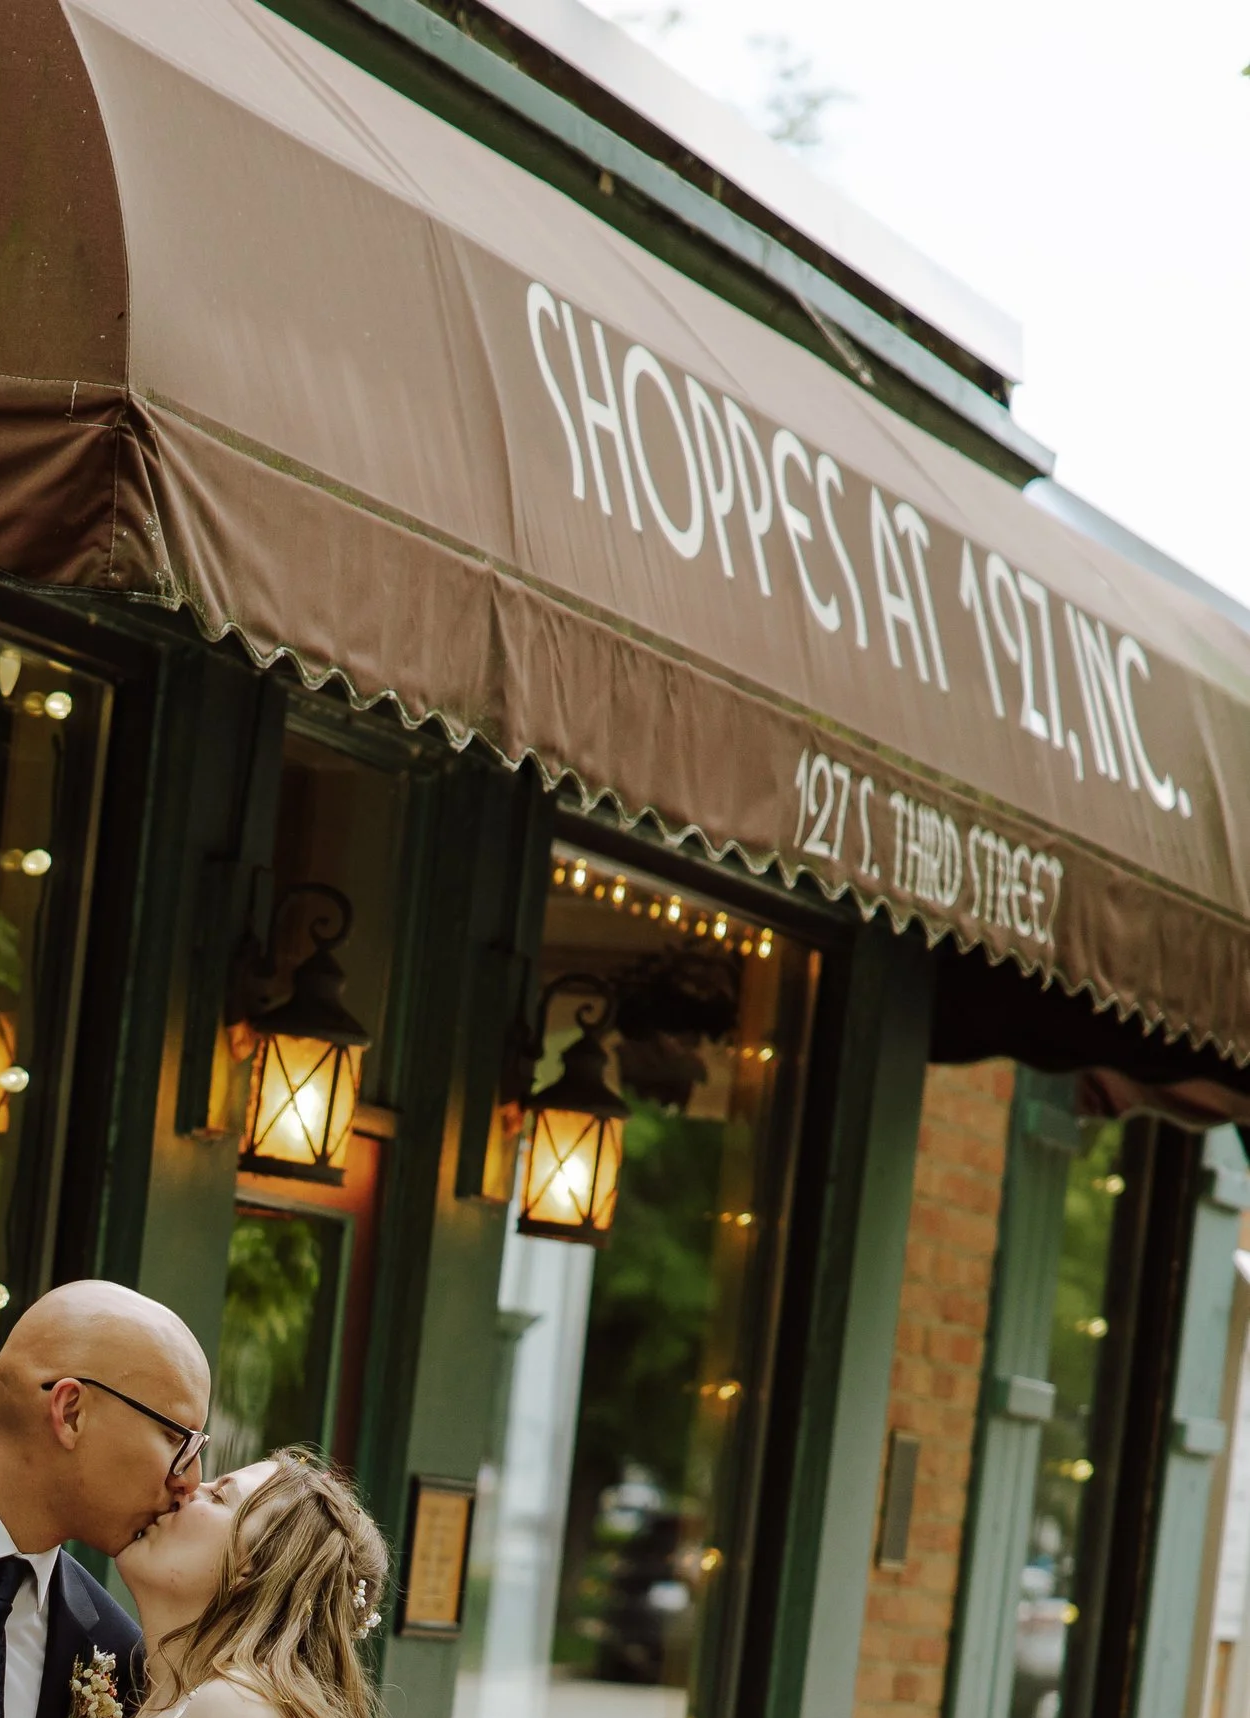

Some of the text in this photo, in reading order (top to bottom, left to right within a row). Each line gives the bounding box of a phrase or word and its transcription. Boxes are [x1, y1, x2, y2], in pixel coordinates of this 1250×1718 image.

[526, 281, 868, 650] SHOPPES
[870, 484, 948, 692] AT
[1064, 600, 1192, 819] INC.
[793, 747, 1063, 948] 127 S. THIRD STREET
